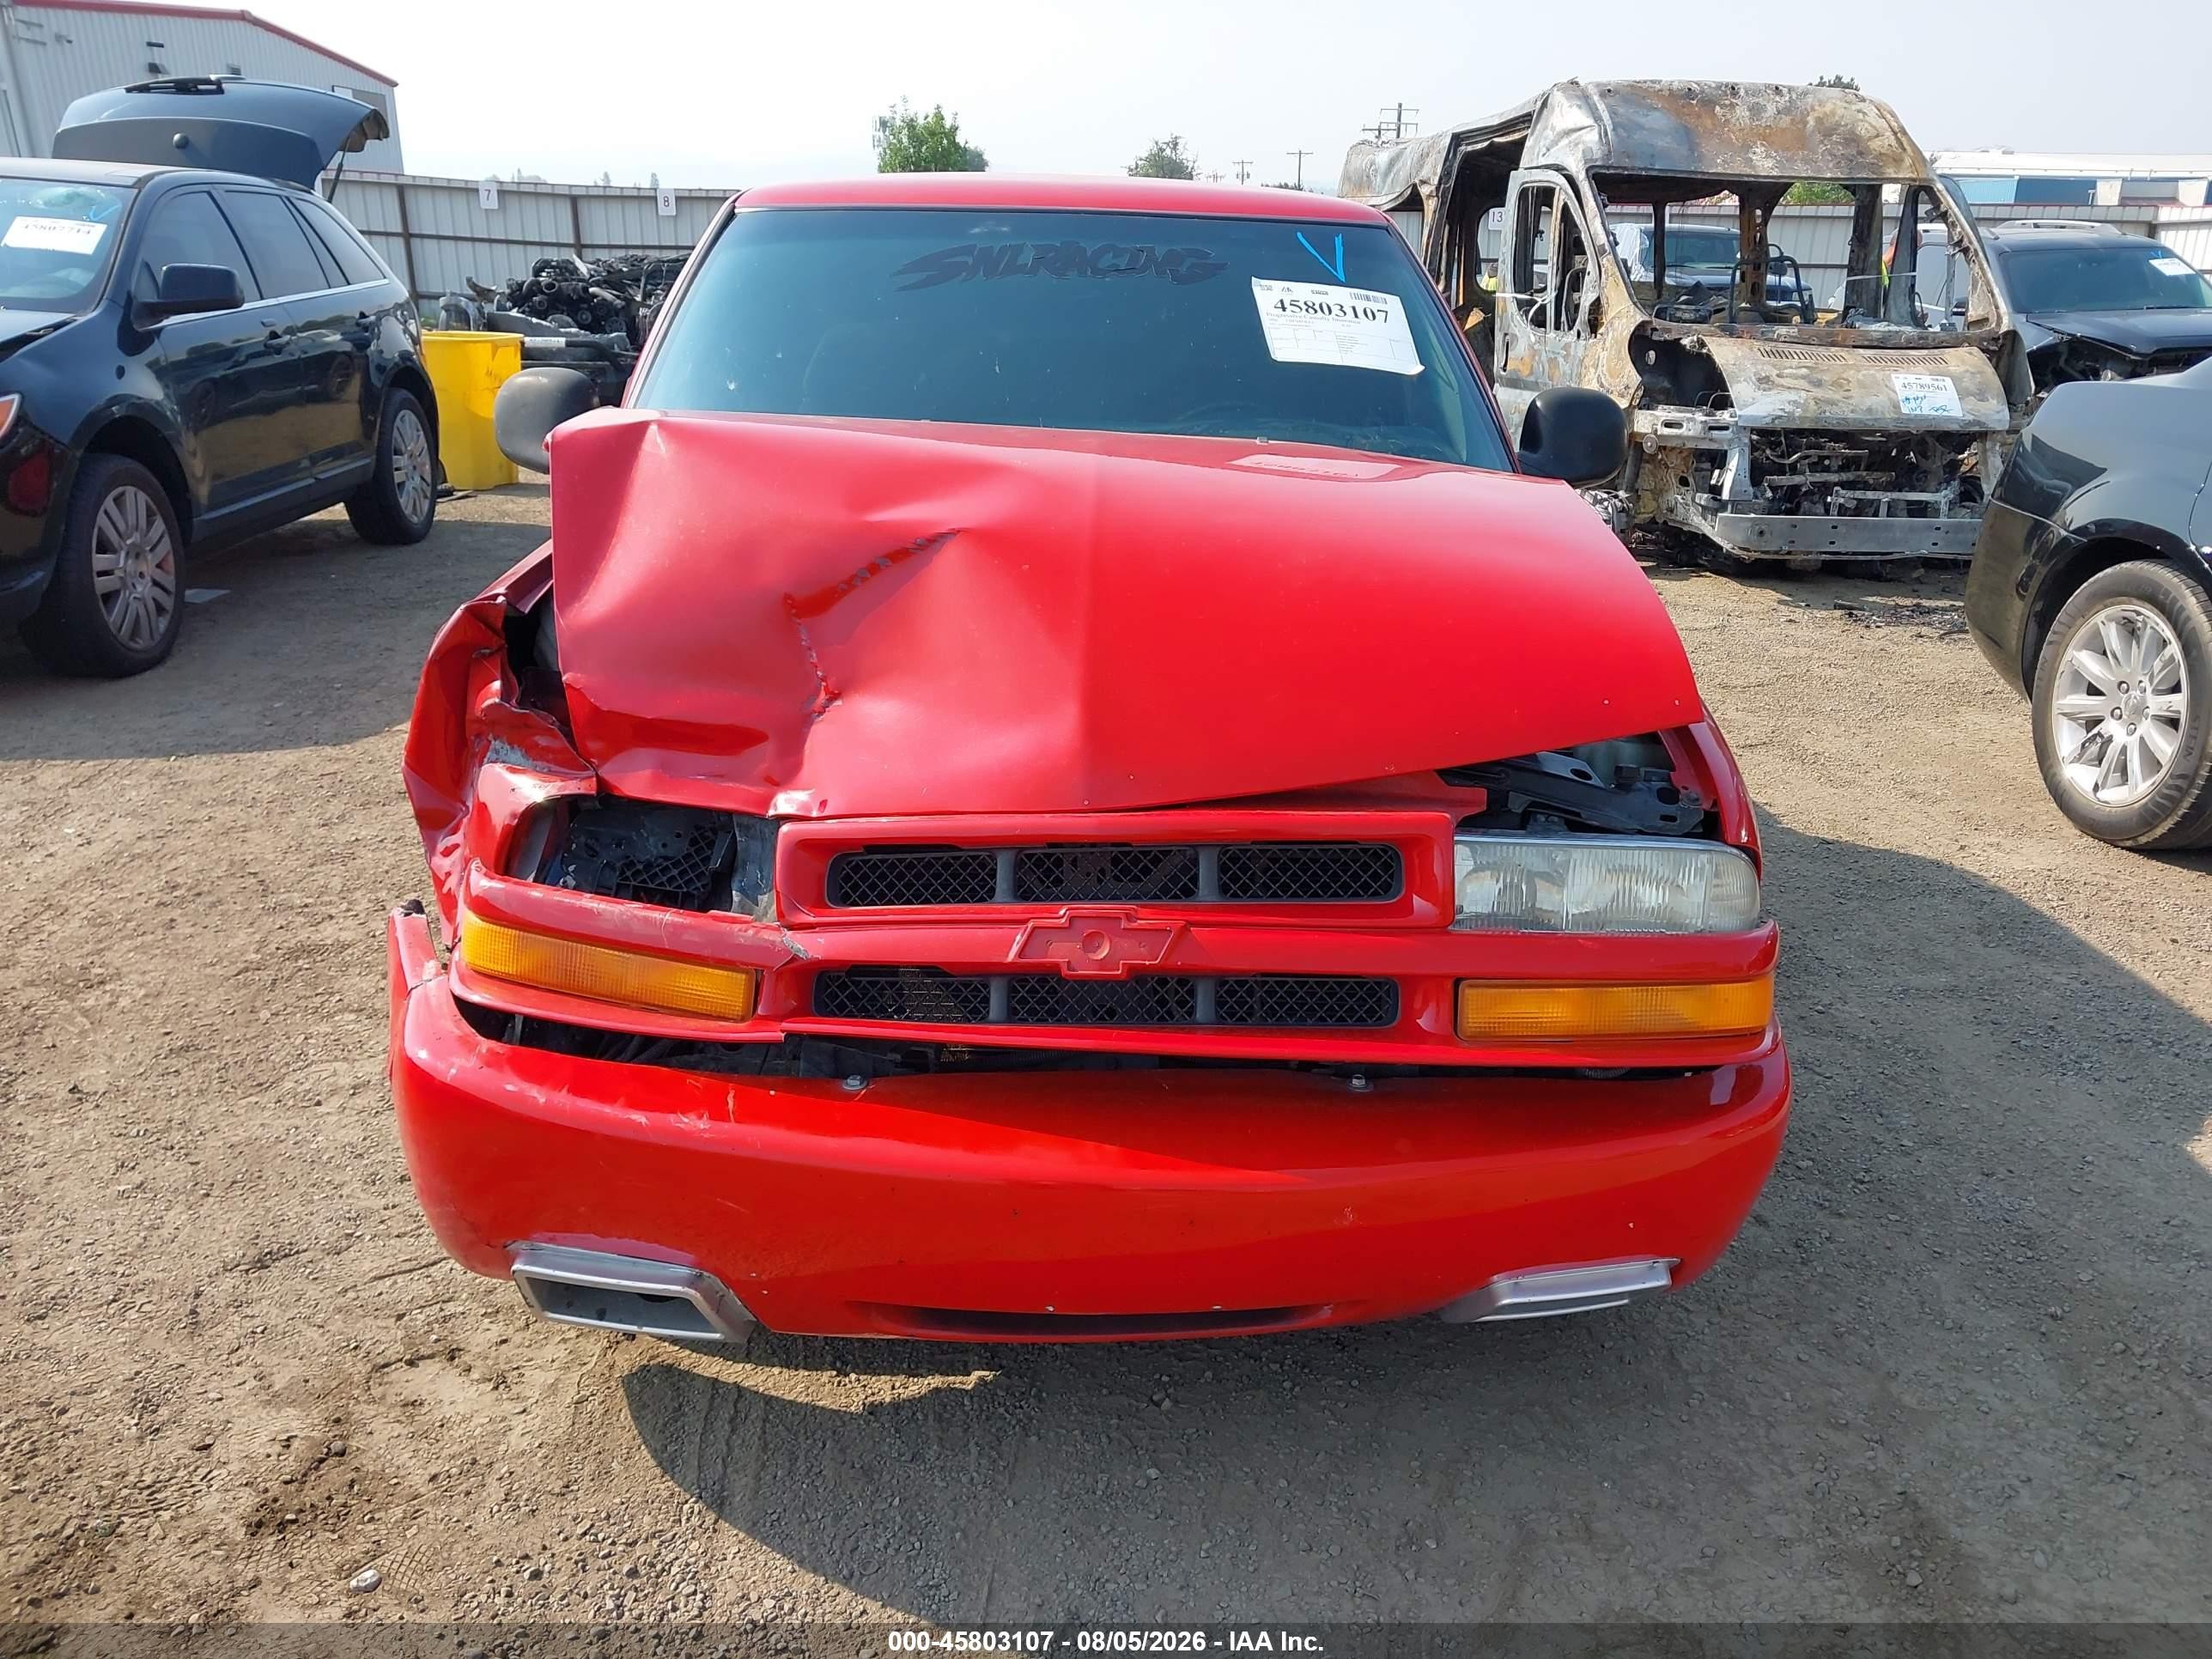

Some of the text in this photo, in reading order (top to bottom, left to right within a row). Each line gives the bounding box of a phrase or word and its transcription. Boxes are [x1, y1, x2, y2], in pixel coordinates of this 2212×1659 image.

[483, 189, 492, 202] 7
[662, 196, 671, 208] 8
[1492, 211, 1503, 222] 13
[1273, 297, 1389, 324] 45803107
